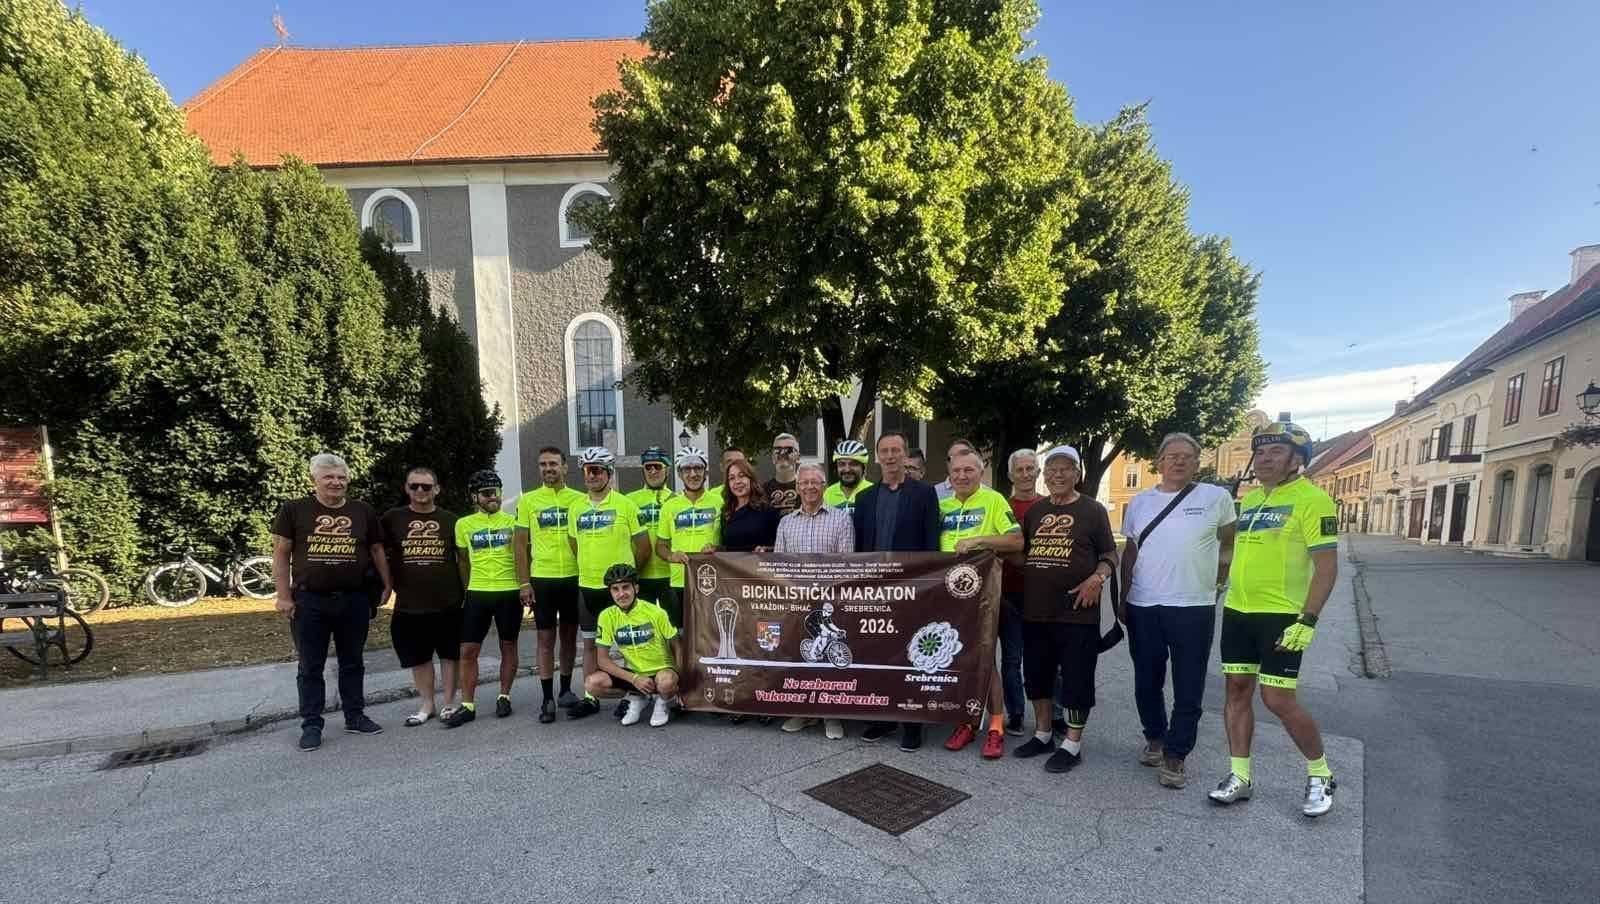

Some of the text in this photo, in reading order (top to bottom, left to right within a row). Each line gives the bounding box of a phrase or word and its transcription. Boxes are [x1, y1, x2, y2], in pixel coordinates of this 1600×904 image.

[314, 514, 353, 535] 22
[1253, 511, 1283, 522] ETAK
[407, 519, 440, 539] 22
[1034, 513, 1074, 537] 22
[307, 543, 356, 554] MARATON
[403, 546, 445, 556] MARATON
[742, 583, 916, 601] BICIKLISTIČKI MARATON
[859, 618, 898, 634] 2026.
[783, 678, 858, 692] Ne zaboravi
[904, 673, 959, 683] Srebrenica
[754, 690, 890, 706] Vukovar i Srebrenicu
